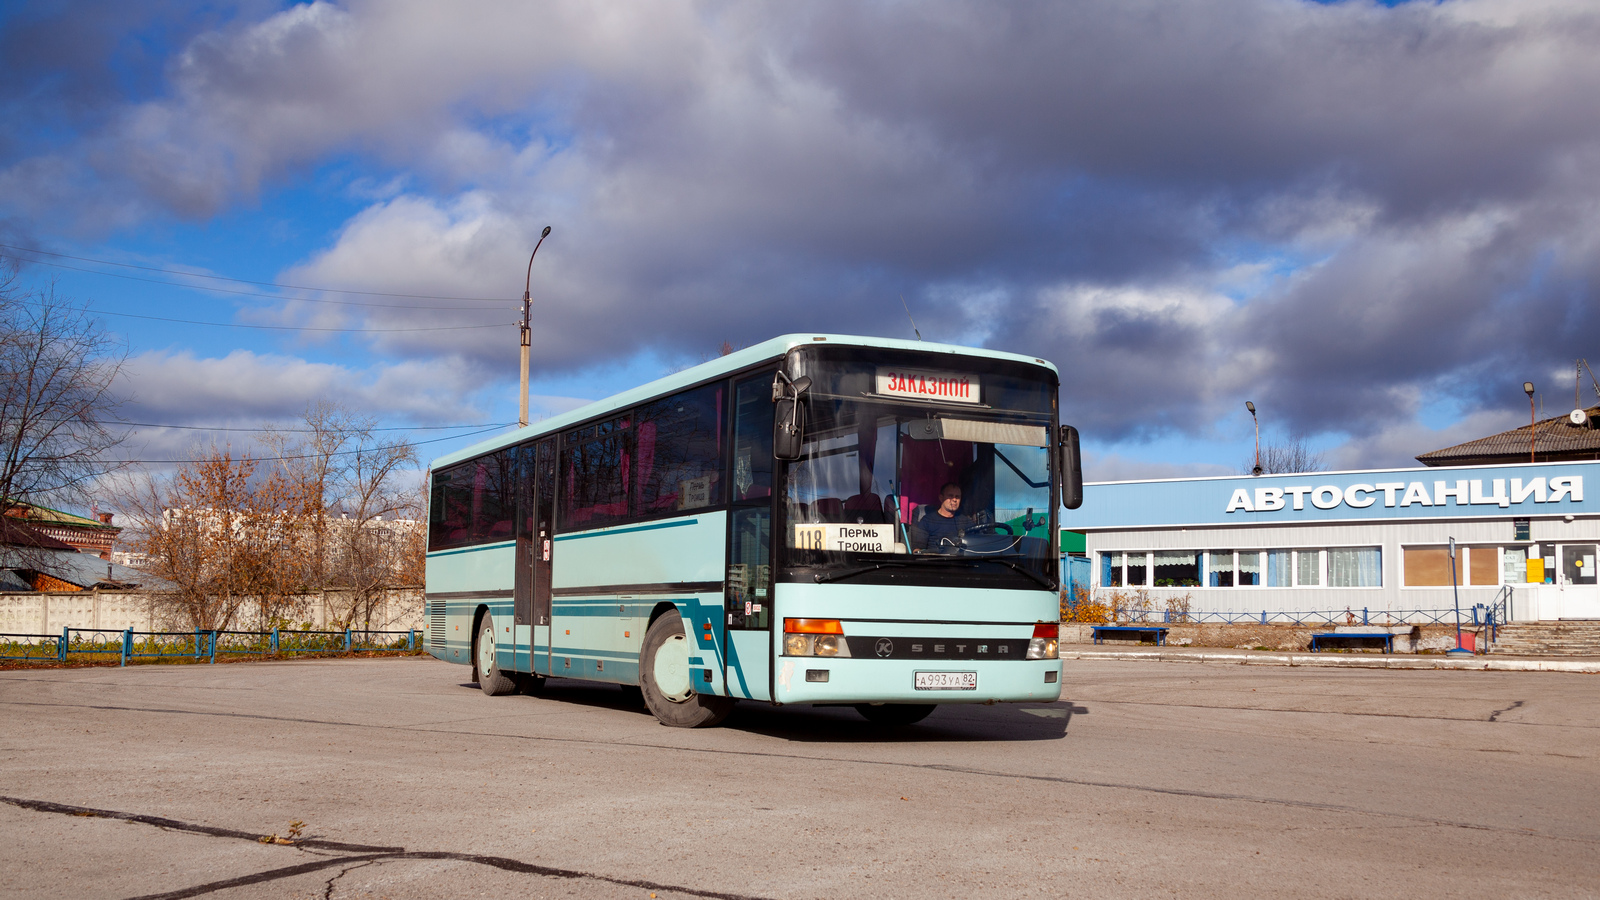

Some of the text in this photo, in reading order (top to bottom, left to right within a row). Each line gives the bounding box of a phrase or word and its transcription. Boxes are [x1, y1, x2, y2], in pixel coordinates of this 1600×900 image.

[887, 371, 970, 398] ЗАКАЗНОЙ
[1225, 475, 1584, 513] АВТОСТАНЦИЯ
[799, 529, 823, 550] 118
[839, 527, 879, 538] Пермь
[837, 540, 883, 553] Троица
[911, 644, 1009, 654] SETRA
